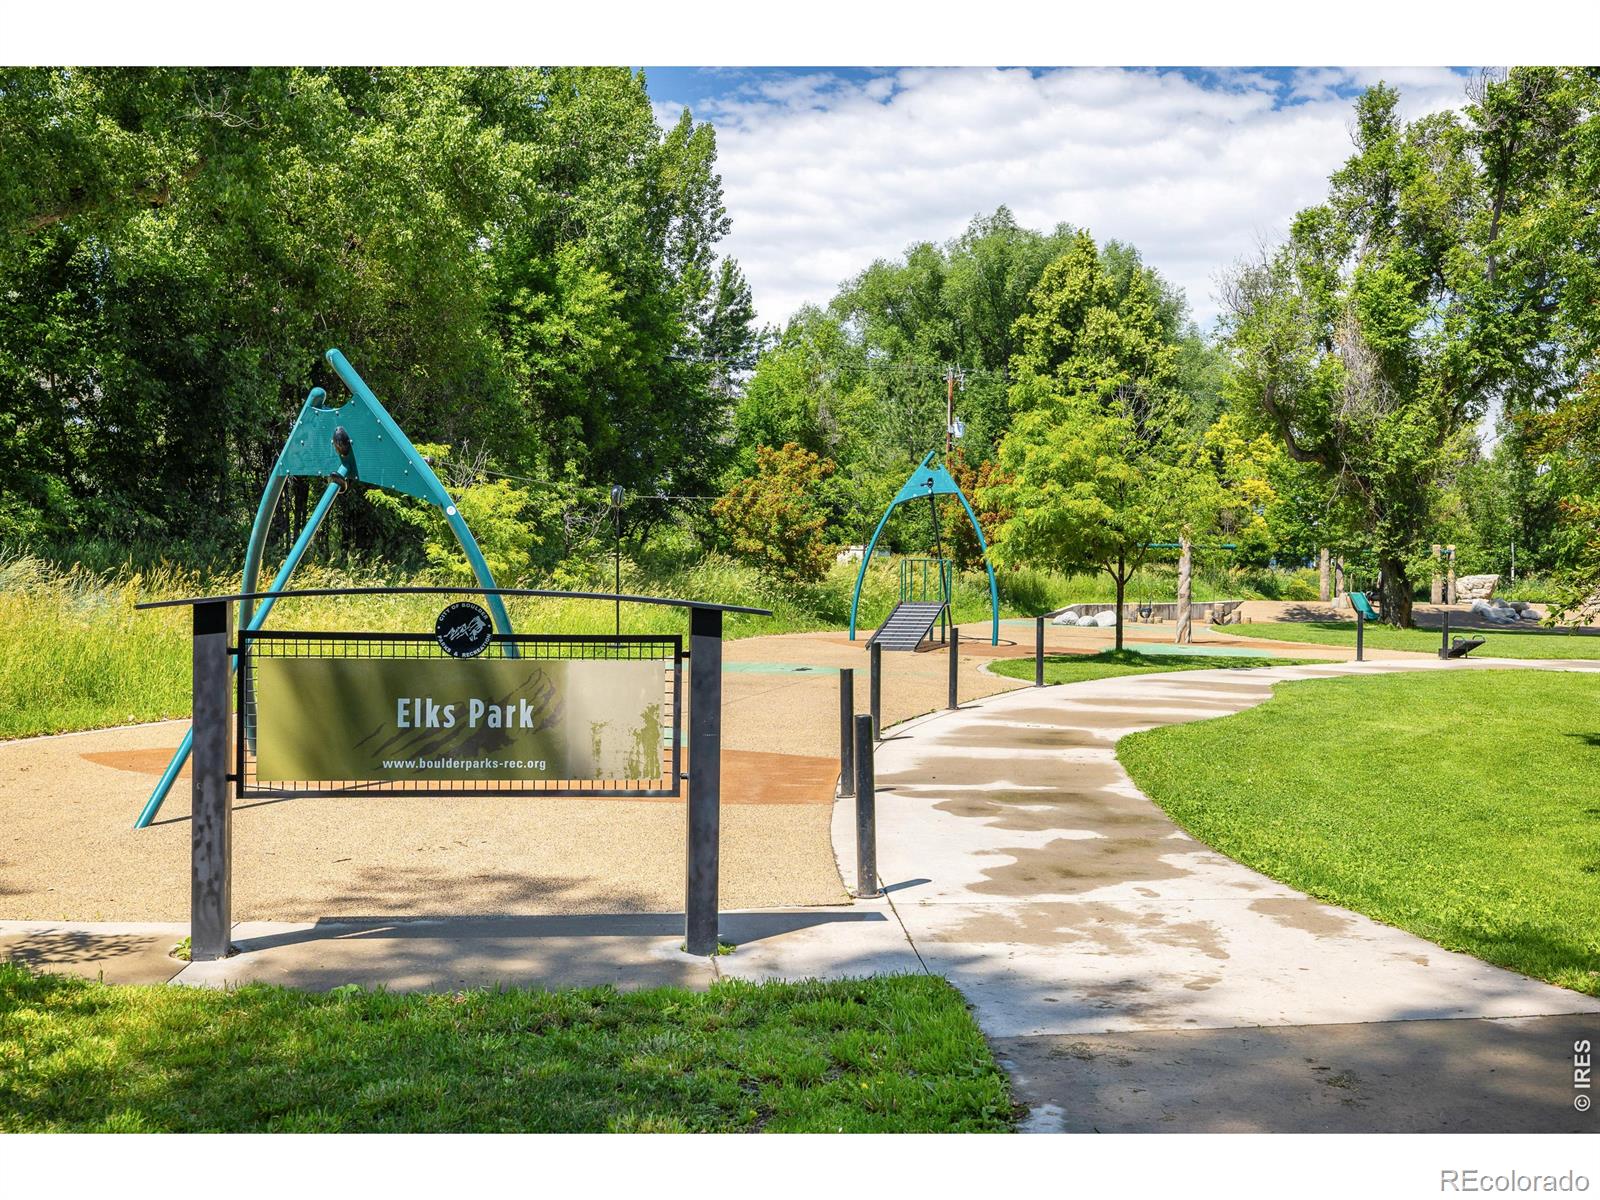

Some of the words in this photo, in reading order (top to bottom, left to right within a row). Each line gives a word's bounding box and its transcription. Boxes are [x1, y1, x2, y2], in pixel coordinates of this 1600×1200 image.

[439, 609, 451, 621] CITY
[461, 603, 488, 620] BOULDER
[437, 635, 452, 653] PARKS
[461, 633, 492, 658] RECREATION
[397, 698, 456, 728] Elks
[469, 698, 534, 728] Park
[382, 758, 547, 771] www.boulderparks-rec.org
